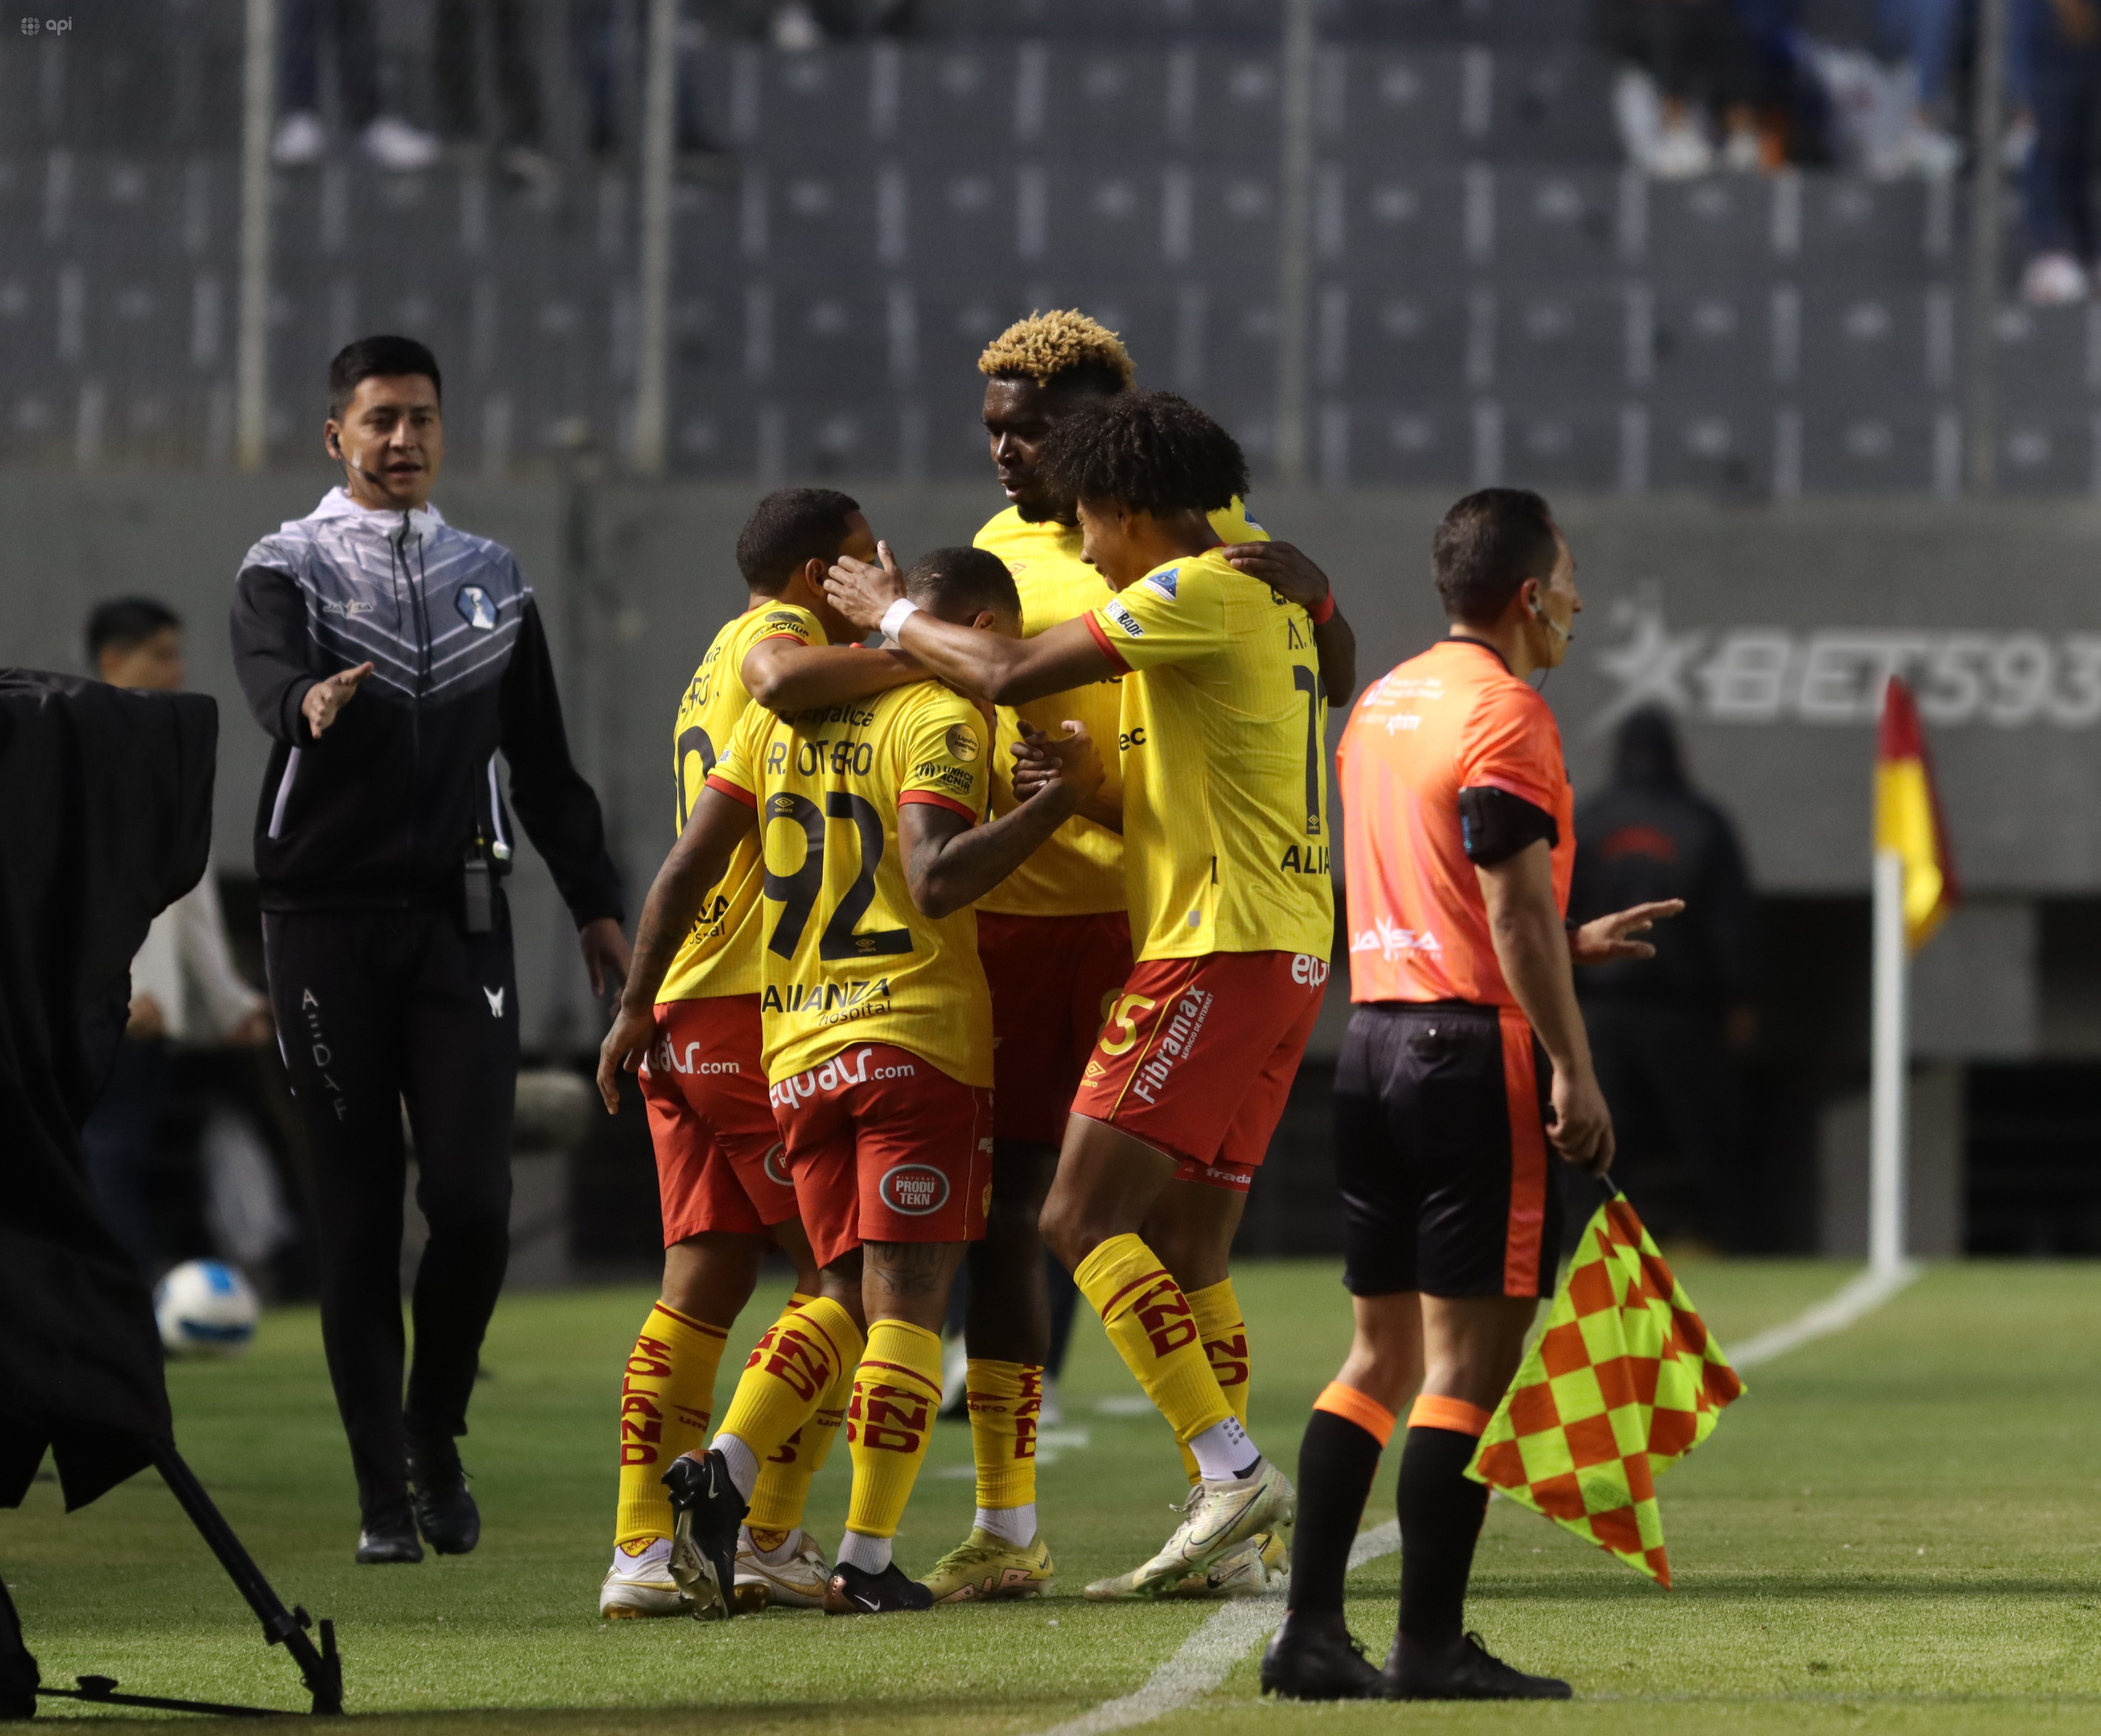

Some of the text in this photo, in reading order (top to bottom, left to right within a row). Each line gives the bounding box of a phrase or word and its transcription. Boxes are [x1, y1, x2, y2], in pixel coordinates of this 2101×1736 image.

[767, 740, 873, 777] R. OTERO
[940, 774, 970, 791] ACNUR
[944, 766, 974, 784] UNHCR
[764, 791, 914, 961] 92
[819, 999, 892, 1026] hospital
[1181, 992, 1214, 1060] SERVICIO DE INTERNET
[1133, 984, 1205, 1104] Fibramax
[896, 1180, 935, 1193] PRODU
[900, 1192, 930, 1205] TEKN
